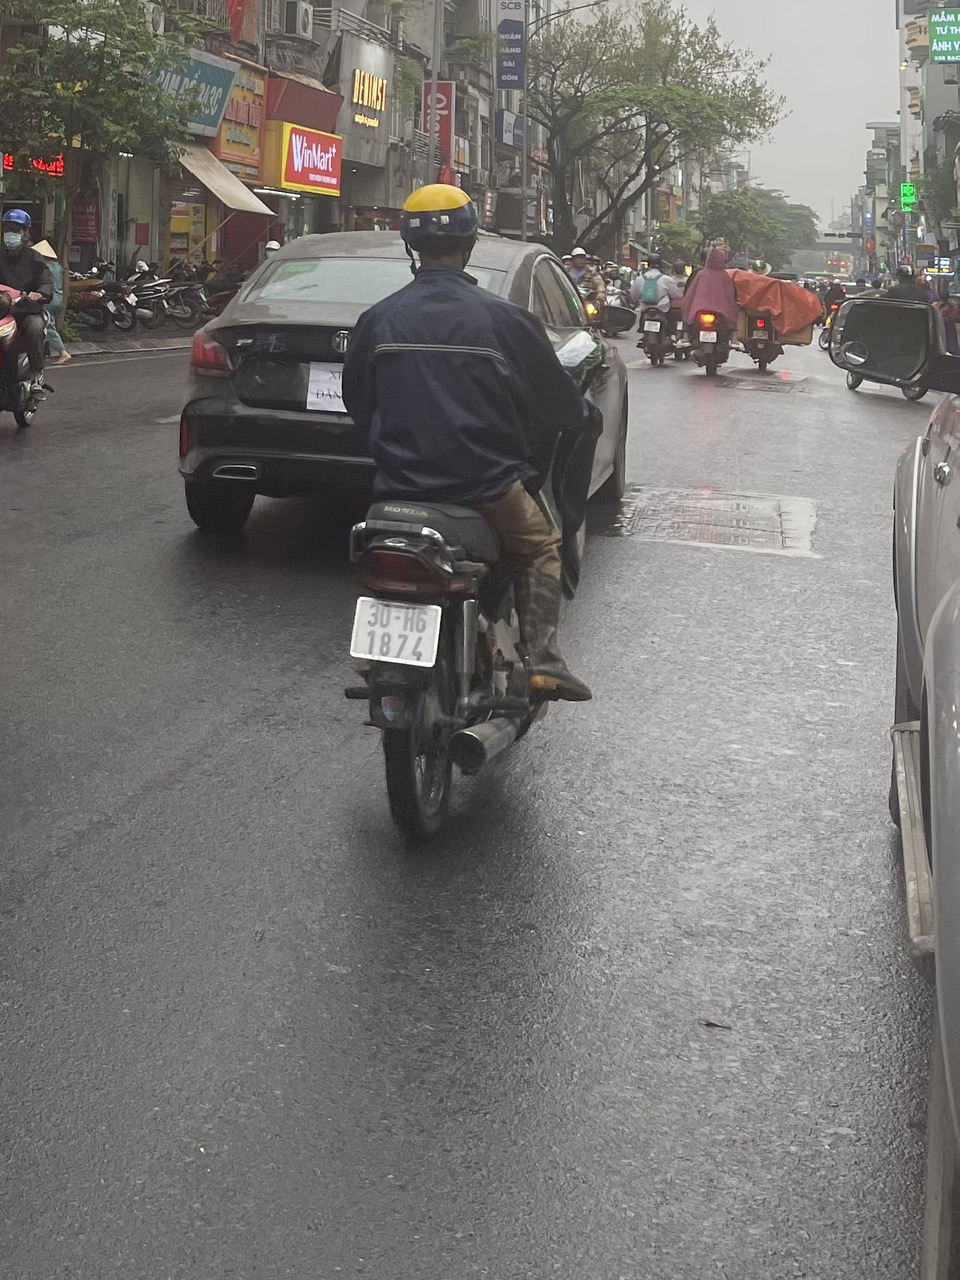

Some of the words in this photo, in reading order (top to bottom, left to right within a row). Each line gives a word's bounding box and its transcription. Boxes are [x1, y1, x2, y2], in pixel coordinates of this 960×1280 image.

[501, 1, 521, 10] SCB
[953, 41, 960, 51] V
[384, 505, 429, 517] HONDA
[367, 630, 422, 661] 1874
